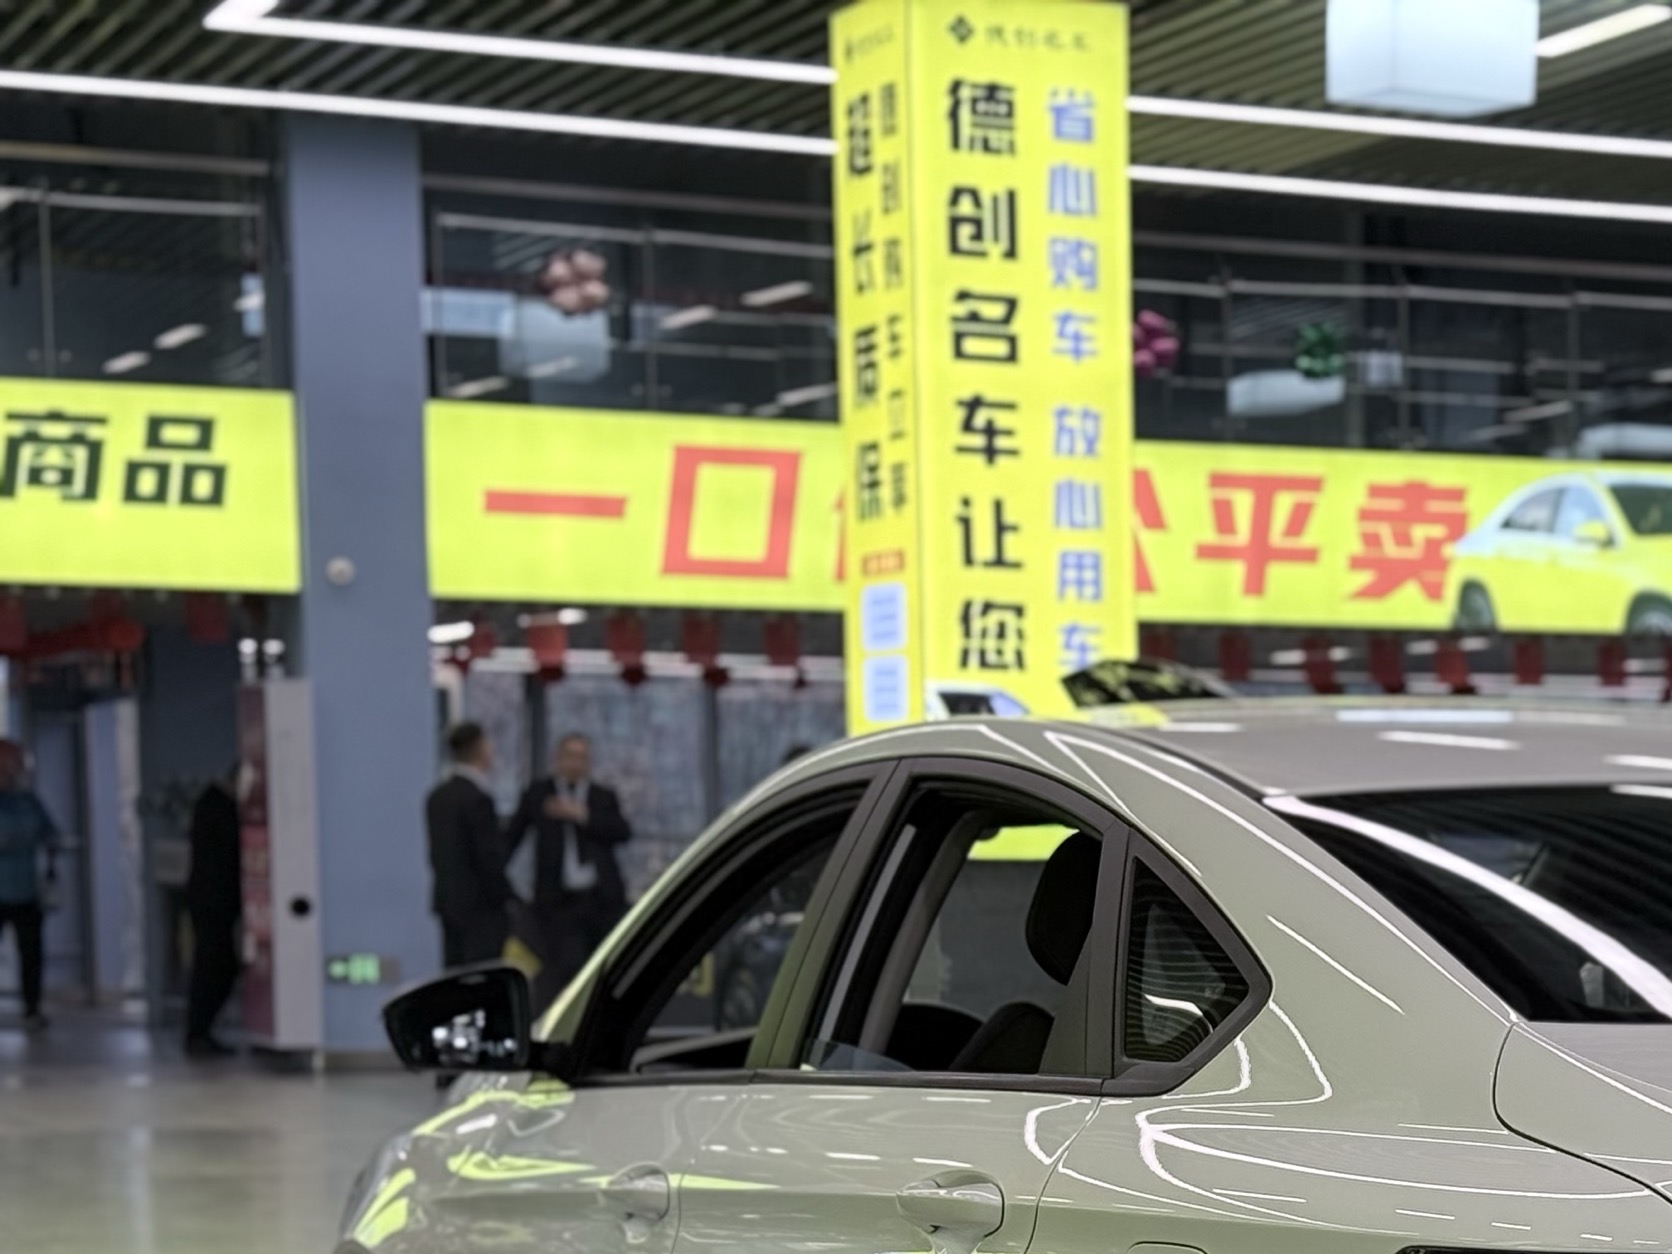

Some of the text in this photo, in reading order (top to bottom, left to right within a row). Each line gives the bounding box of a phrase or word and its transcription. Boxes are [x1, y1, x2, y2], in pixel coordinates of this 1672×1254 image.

[0, 410, 226, 506] 商品
[484, 442, 846, 583] 一口
[947, 78, 1026, 671] 德创名车让您
[1047, 88, 1102, 668] 省心购车 放心用车
